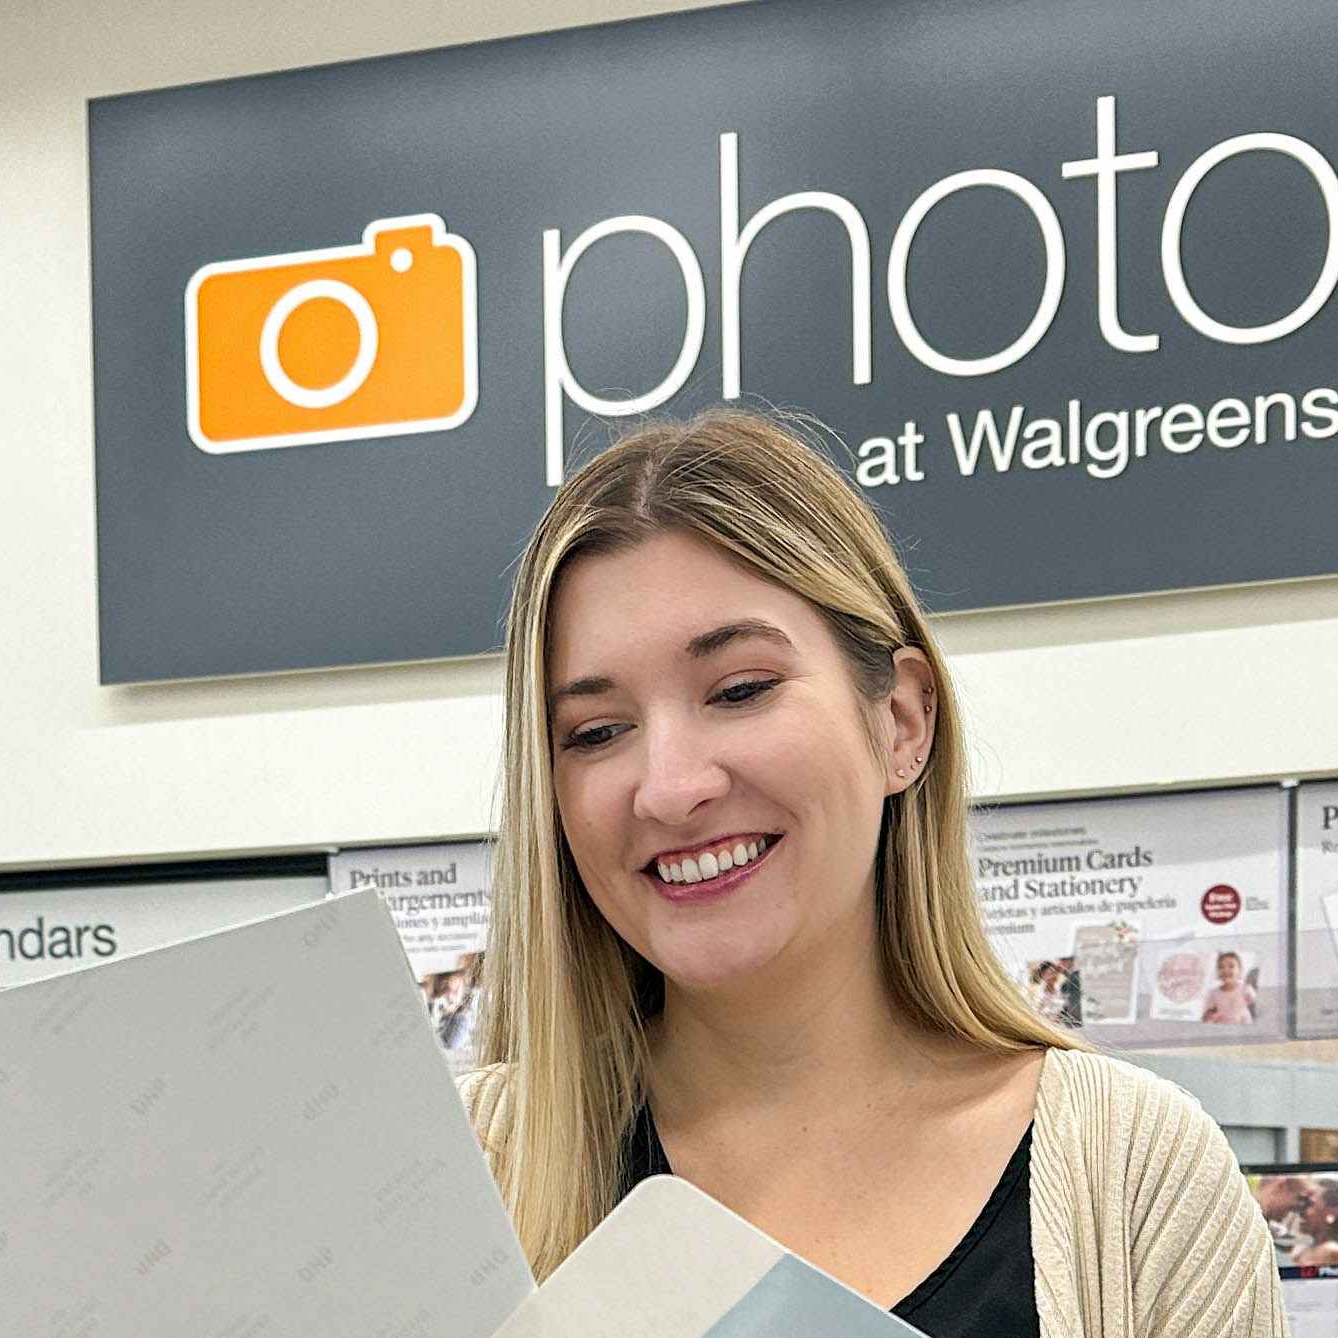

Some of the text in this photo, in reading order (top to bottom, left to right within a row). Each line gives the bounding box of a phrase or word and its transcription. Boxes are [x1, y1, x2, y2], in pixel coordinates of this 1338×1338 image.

[857, 415, 924, 489] at
[350, 864, 457, 888] Prints and
[978, 847, 1153, 878] Premium Cards
[1023, 873, 1143, 899] Stationery
